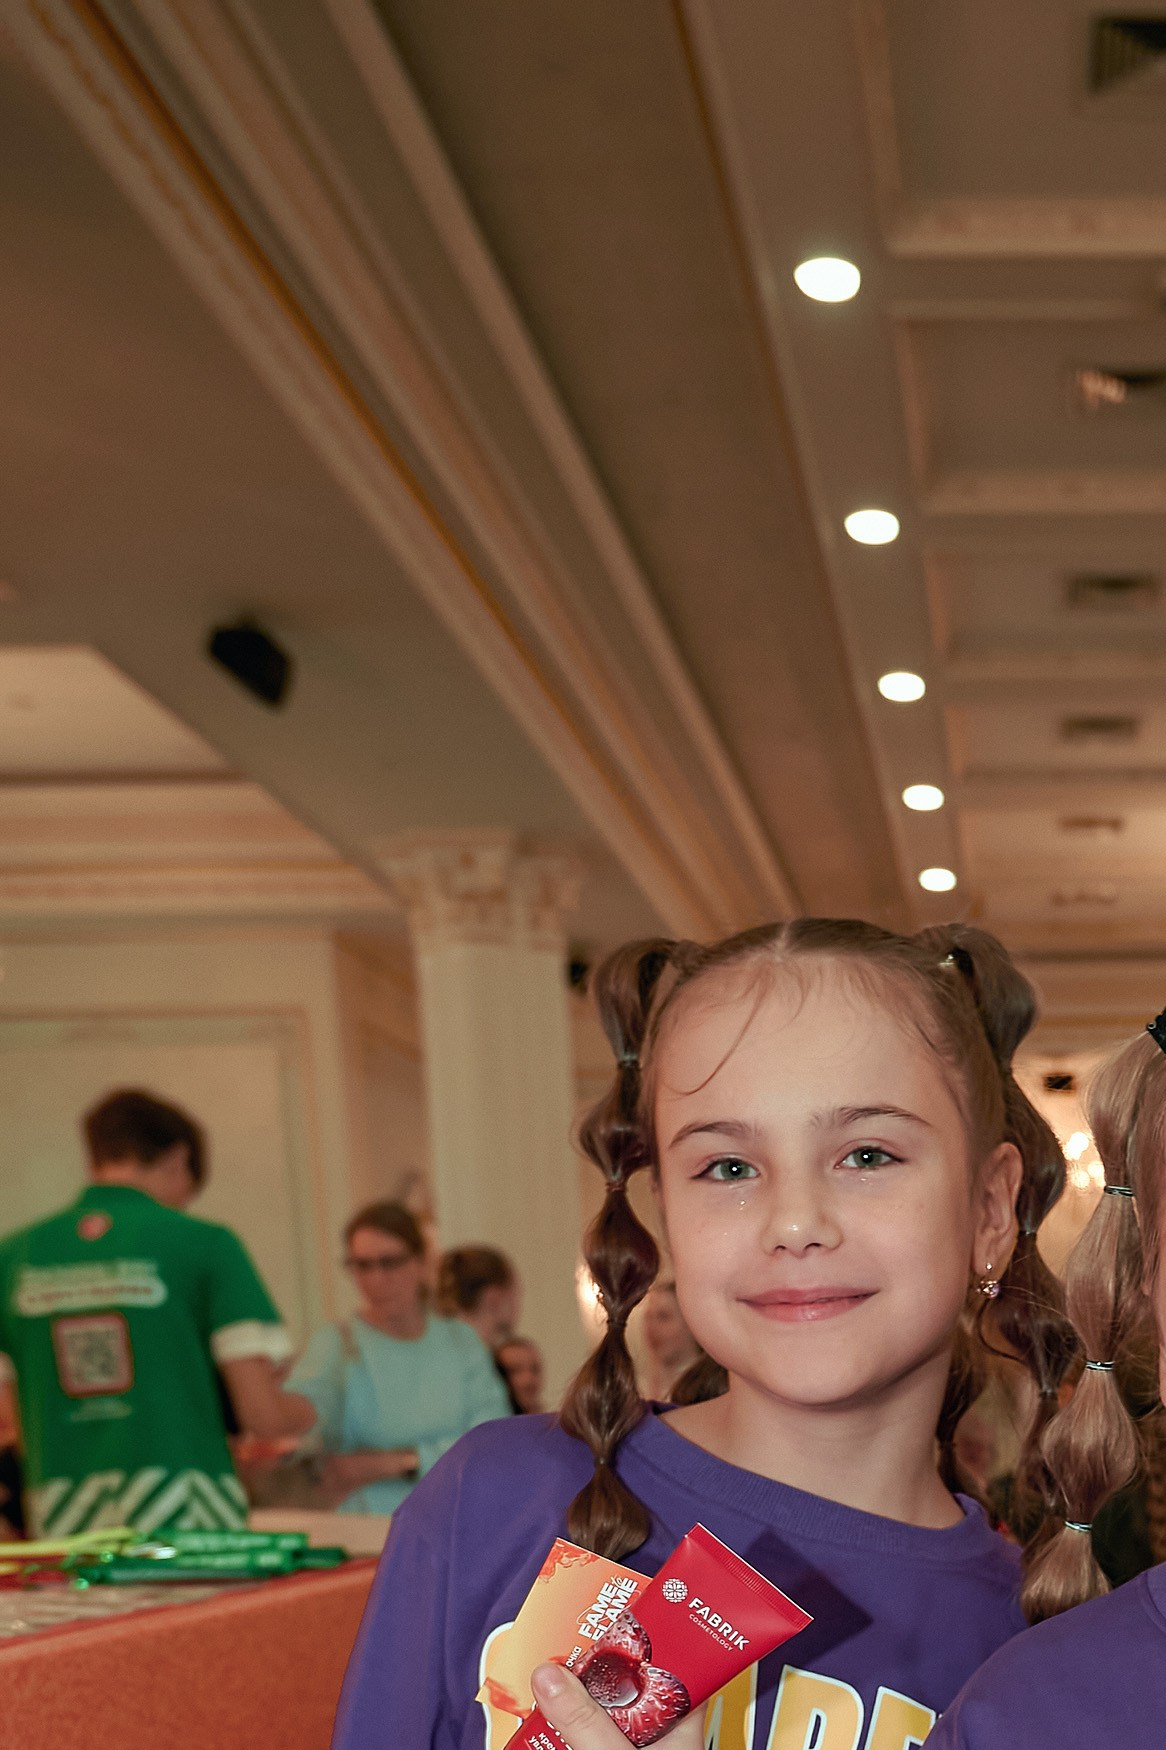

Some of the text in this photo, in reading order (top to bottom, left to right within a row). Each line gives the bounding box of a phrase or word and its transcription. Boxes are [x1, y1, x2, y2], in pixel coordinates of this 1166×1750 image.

[578, 1582, 618, 1638] FAME
[591, 1577, 638, 1640] FLAME
[688, 1597, 750, 1650] FABRIK
[689, 1613, 733, 1651] COSMETOLOGY
[565, 1645, 582, 1668] очка
